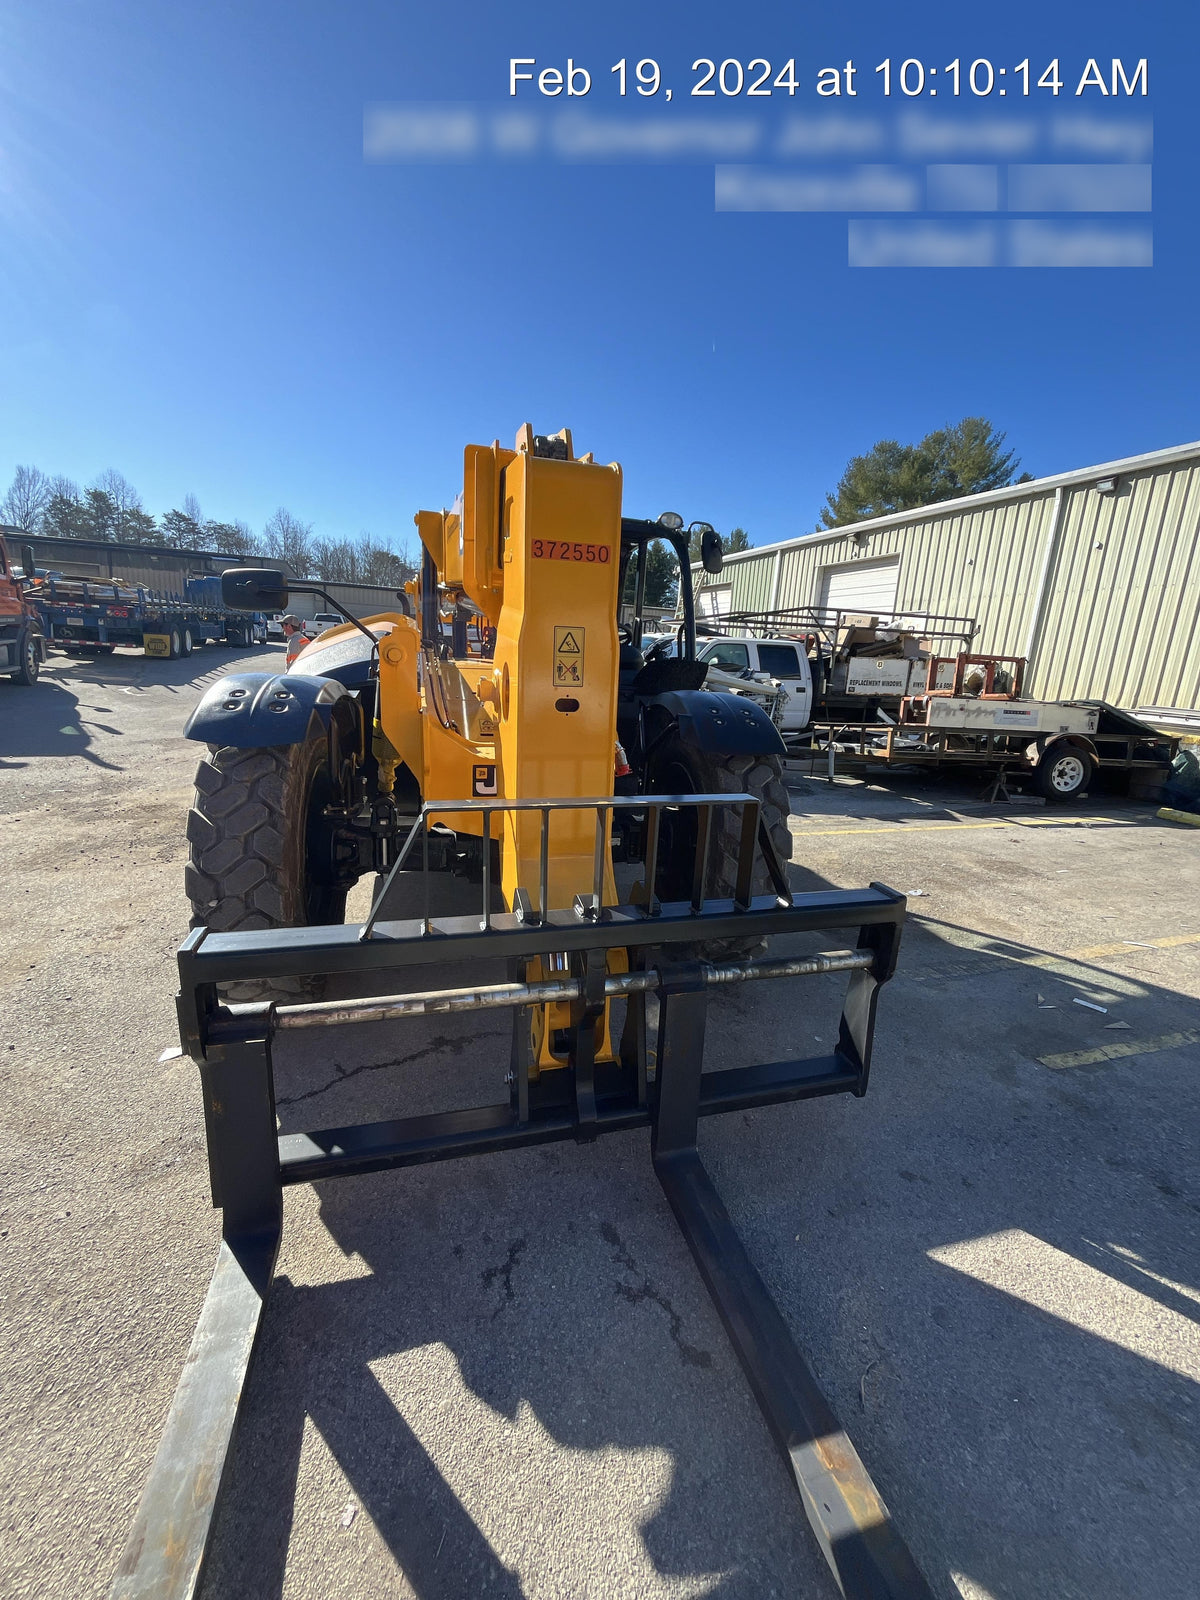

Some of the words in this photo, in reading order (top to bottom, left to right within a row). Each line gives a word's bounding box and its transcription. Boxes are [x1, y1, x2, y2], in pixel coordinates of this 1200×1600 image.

[533, 540, 609, 563] 372550
[849, 679, 881, 687] REPLACEMENT
[881, 680, 902, 688] WINDOWS
